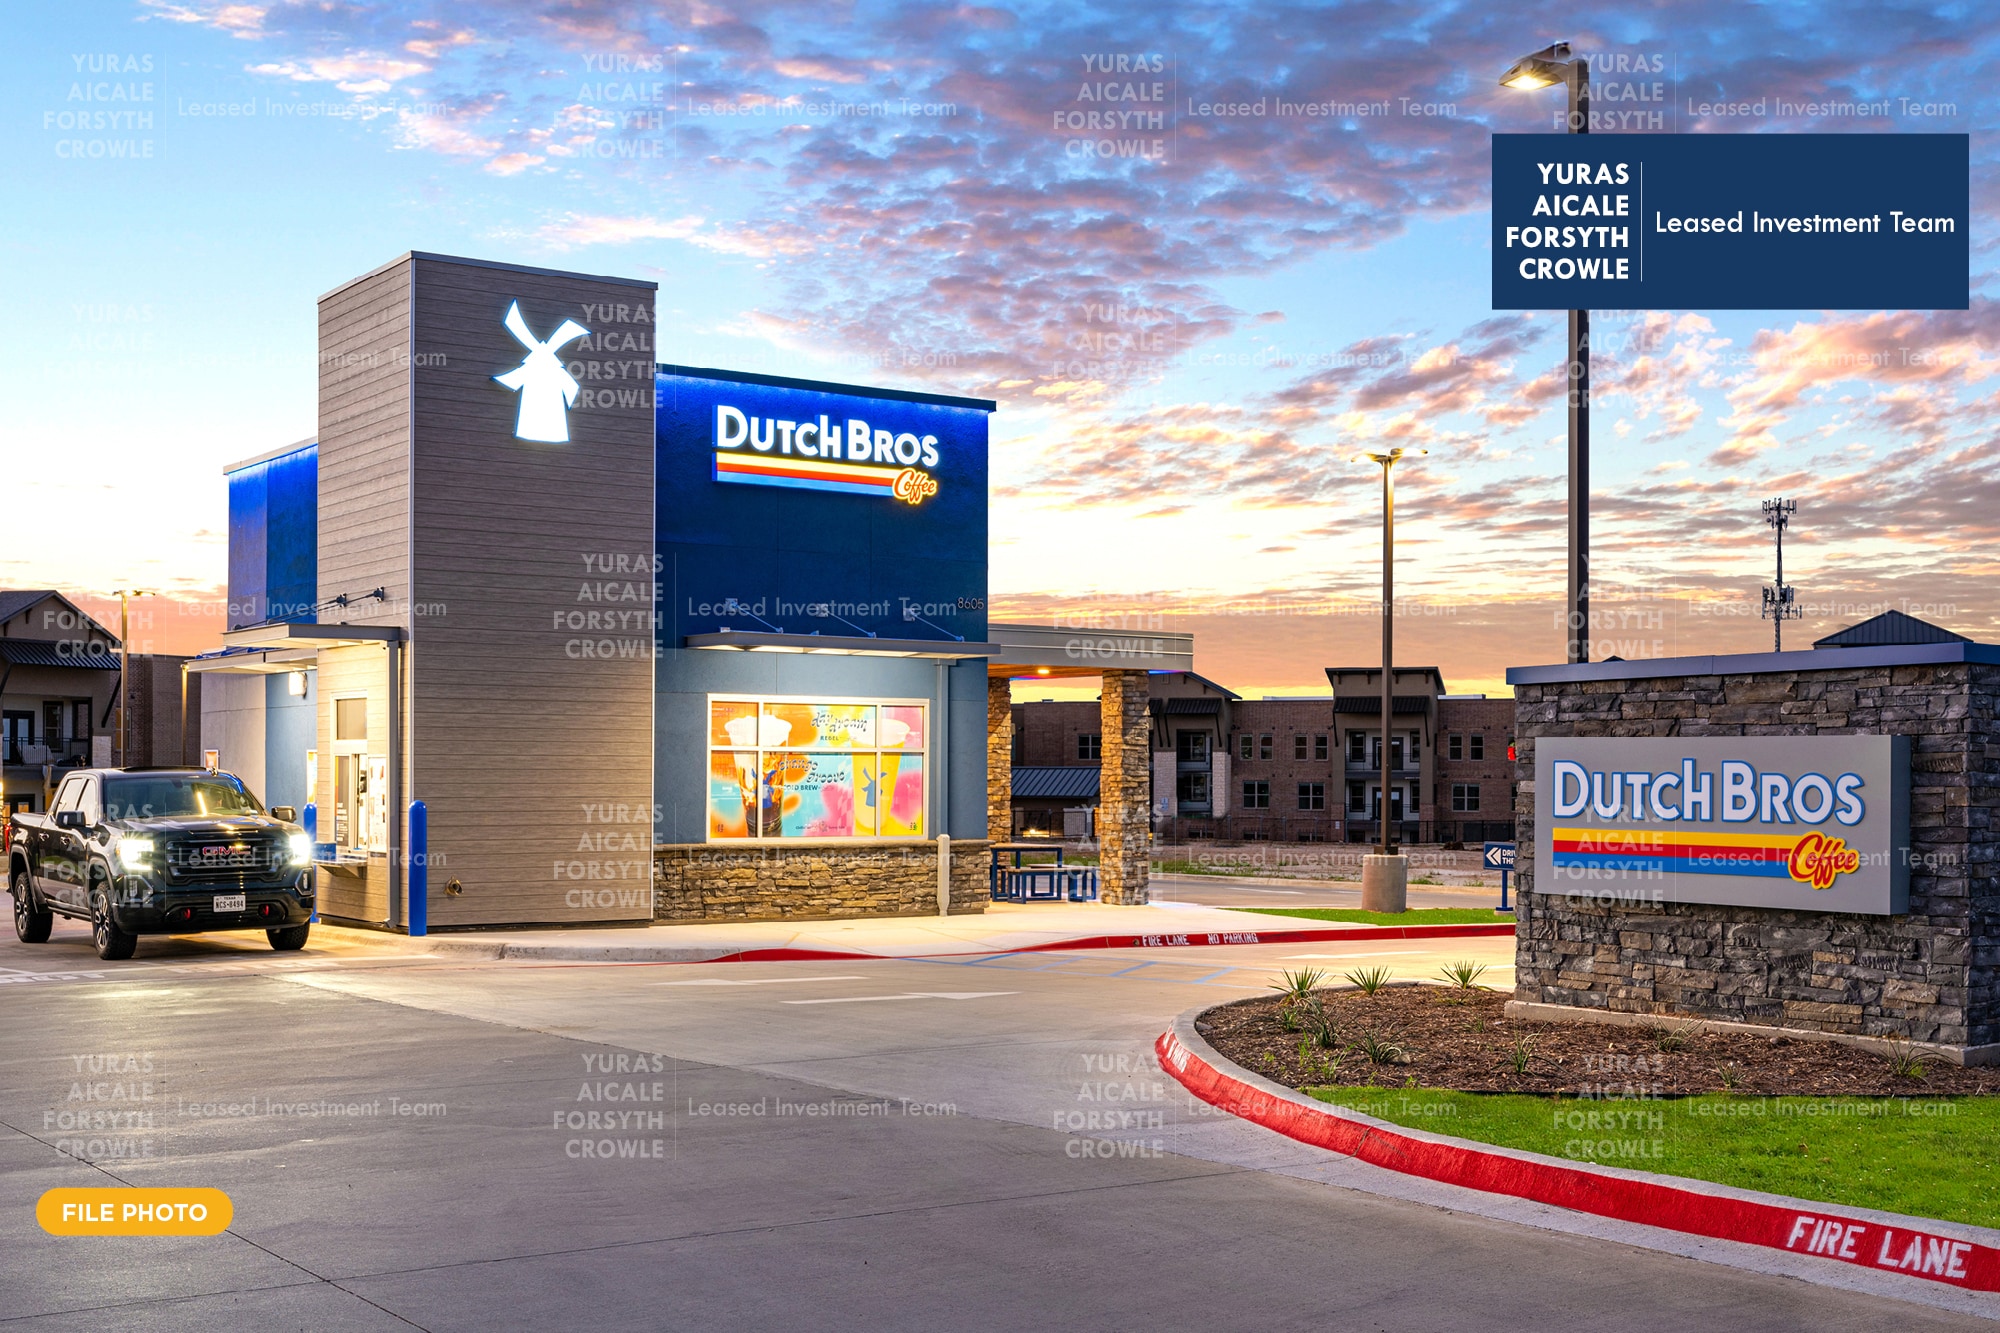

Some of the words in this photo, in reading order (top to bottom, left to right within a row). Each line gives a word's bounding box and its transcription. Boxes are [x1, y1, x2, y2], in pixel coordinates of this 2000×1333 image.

[847, 419, 939, 467] BROS
[893, 468, 938, 504] Coffee
[957, 596, 985, 610] 8605
[1721, 759, 1865, 826] BROS
[202, 845, 251, 855] GMC
[1791, 832, 1859, 890] Coffee
[1142, 935, 1163, 947] FIRE
[1165, 934, 1190, 946] LANE
[1207, 933, 1220, 945] NO
[1222, 932, 1259, 944] PARKING
[1786, 1215, 1866, 1259] FIRE
[1877, 1230, 1972, 1279] LANE
